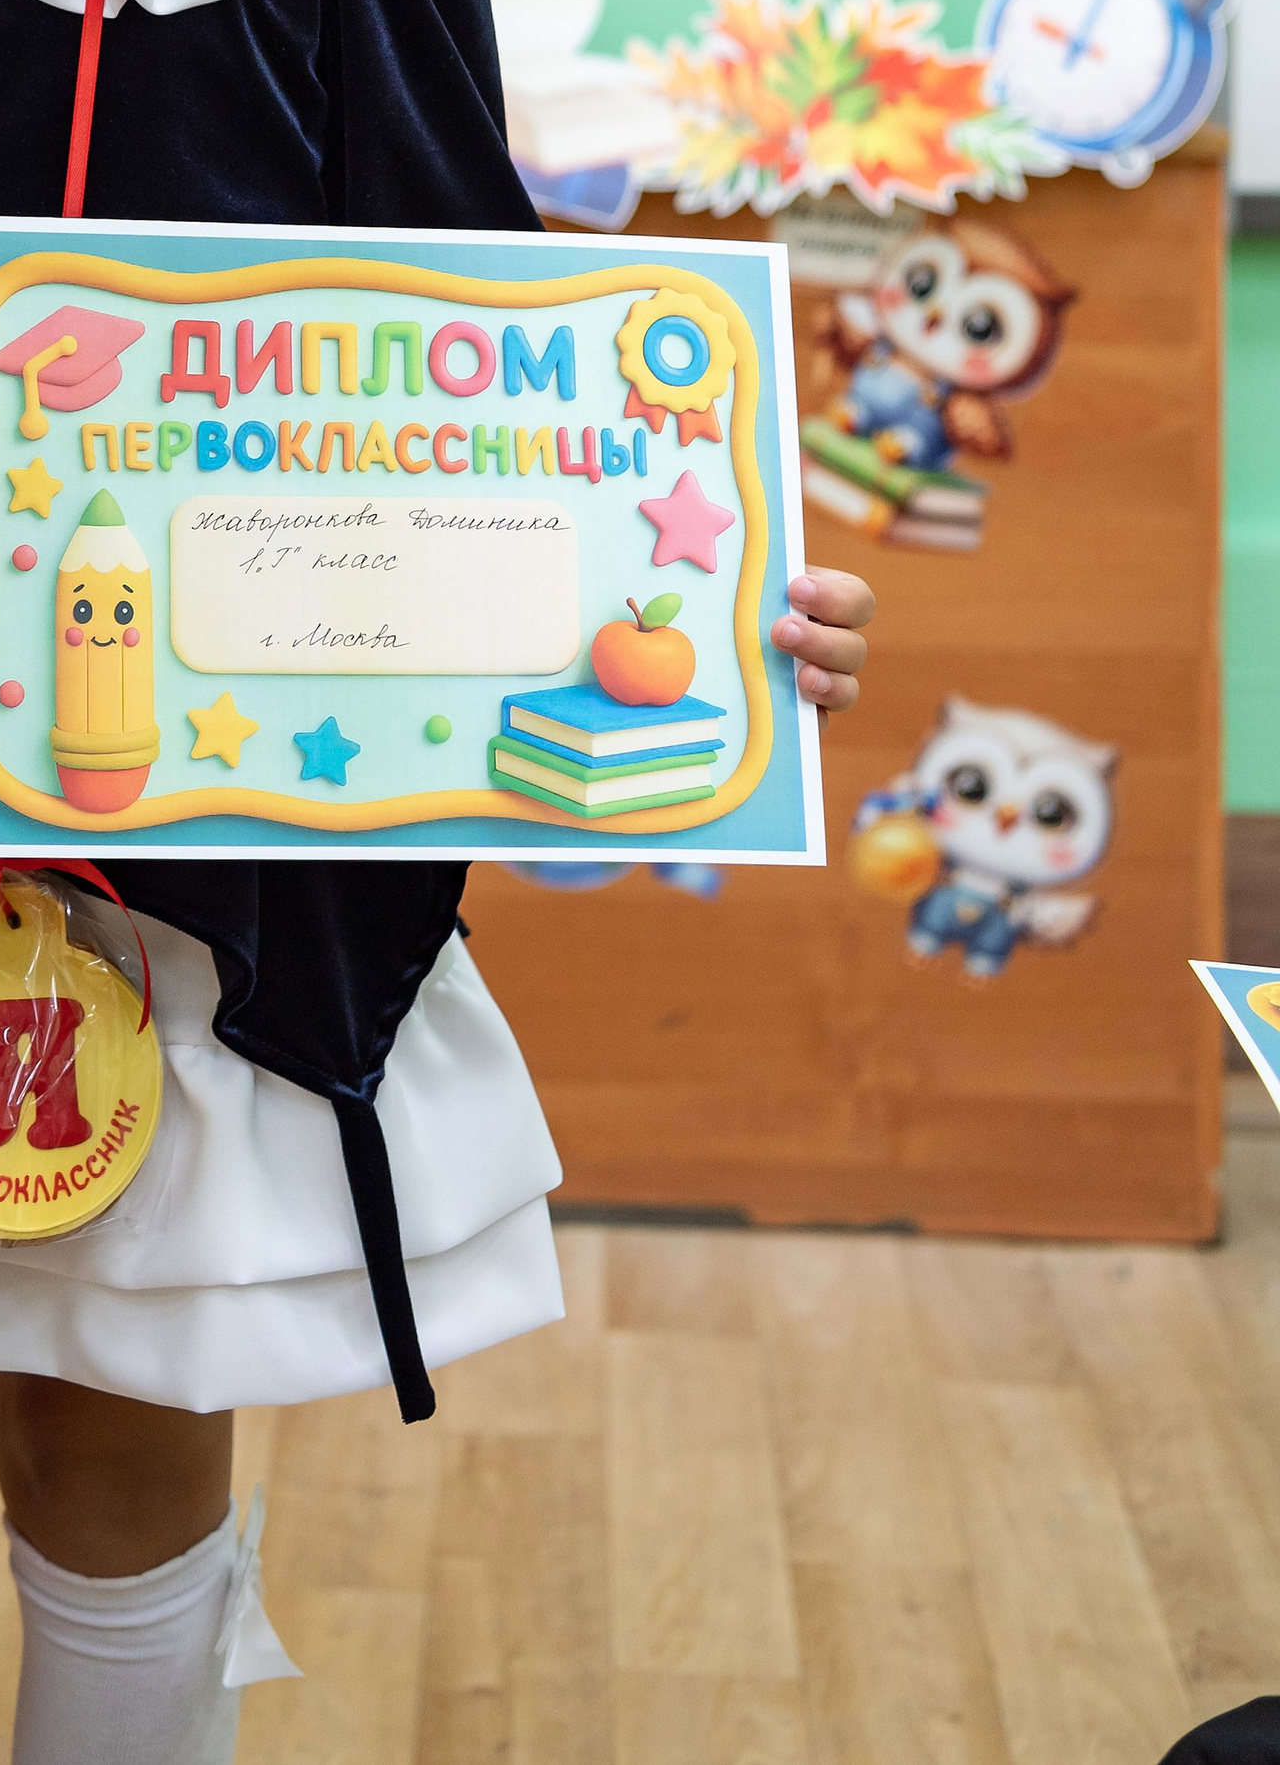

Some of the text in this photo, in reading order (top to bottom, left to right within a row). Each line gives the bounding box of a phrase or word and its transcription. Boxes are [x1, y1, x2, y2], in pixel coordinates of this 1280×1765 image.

[160, 319, 577, 409] ДИПЛОМ
[81, 420, 648, 484] ПЕРВОКЛАССНИЦЫ
[408, 507, 571, 532] Доминика
[312, 552, 399, 571] класс
[292, 622, 411, 650] Москва
